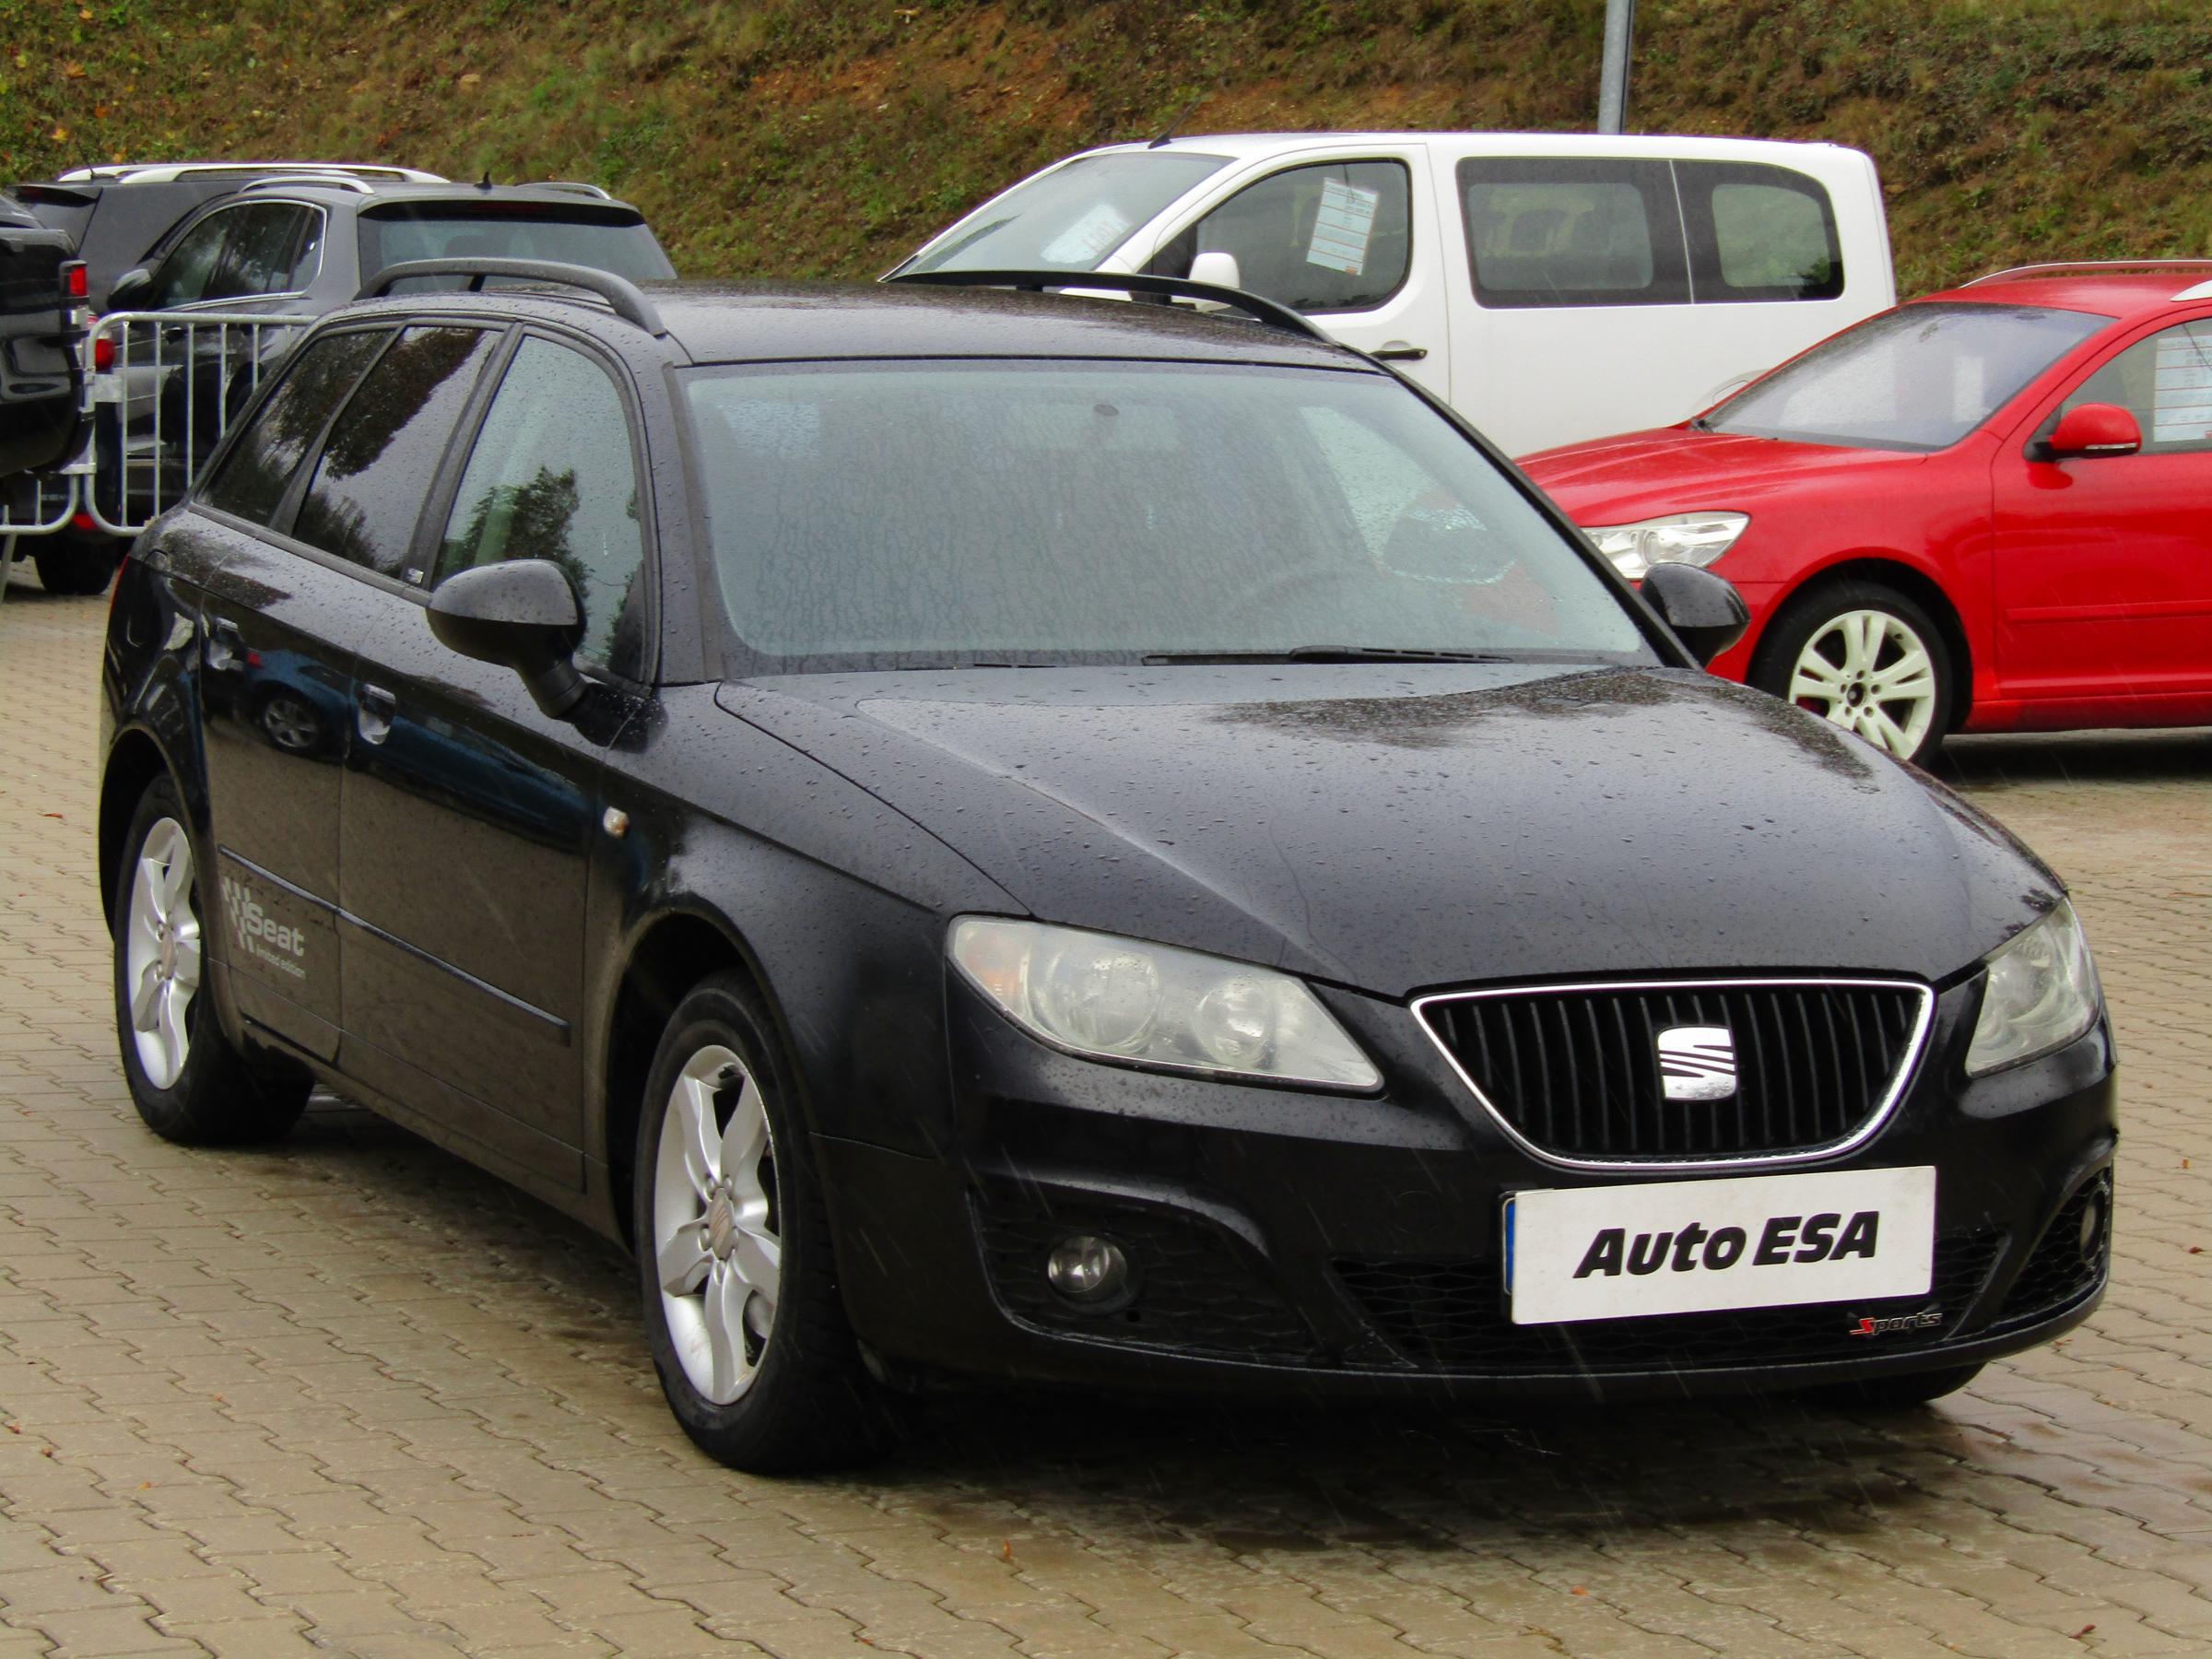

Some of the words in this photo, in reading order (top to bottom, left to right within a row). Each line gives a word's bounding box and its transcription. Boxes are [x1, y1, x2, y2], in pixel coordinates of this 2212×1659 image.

[244, 902, 305, 957] Seat
[1572, 1222, 1747, 1278] Auto
[1753, 1210, 1879, 1265] ESA
